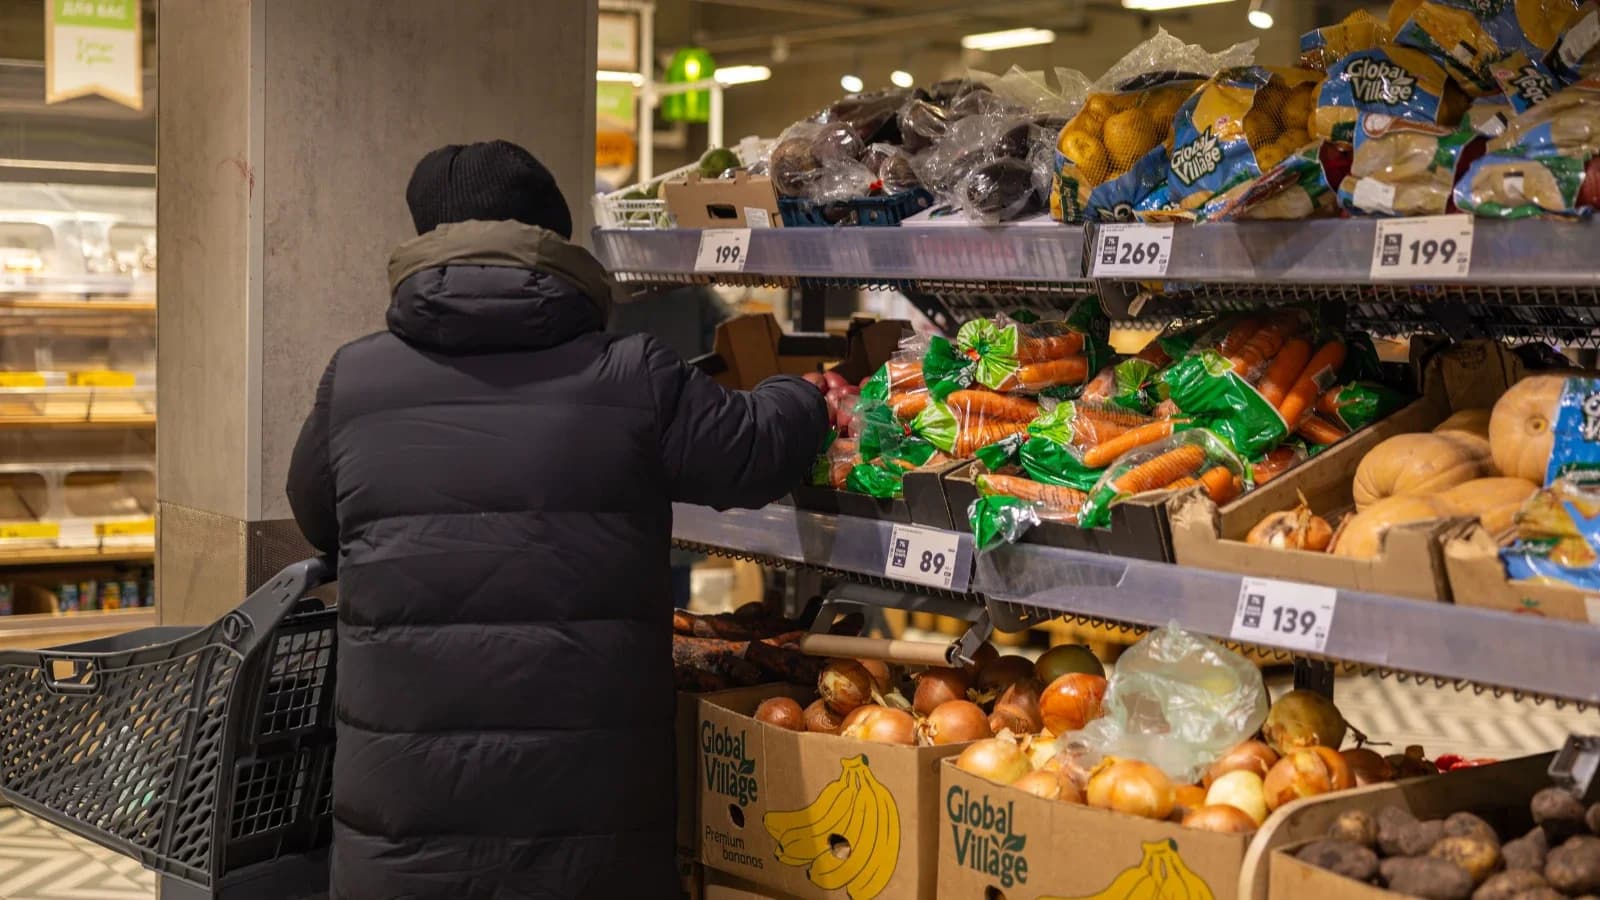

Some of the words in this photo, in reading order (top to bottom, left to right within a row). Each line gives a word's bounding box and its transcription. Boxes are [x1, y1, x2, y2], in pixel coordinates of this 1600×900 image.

[1347, 59, 1407, 79] Global
[1171, 129, 1214, 169] Global
[1175, 146, 1221, 185] Village
[716, 245, 740, 264] 199
[1119, 242, 1160, 264] 269
[1409, 238, 1457, 265] 199
[920, 550, 945, 574] 89
[1273, 606, 1317, 635] 139
[701, 720, 748, 762] Global
[704, 755, 758, 807] Village
[947, 785, 1016, 838] Global
[705, 825, 745, 849] Premium
[723, 847, 764, 870] bananas
[952, 824, 1028, 888] Village
